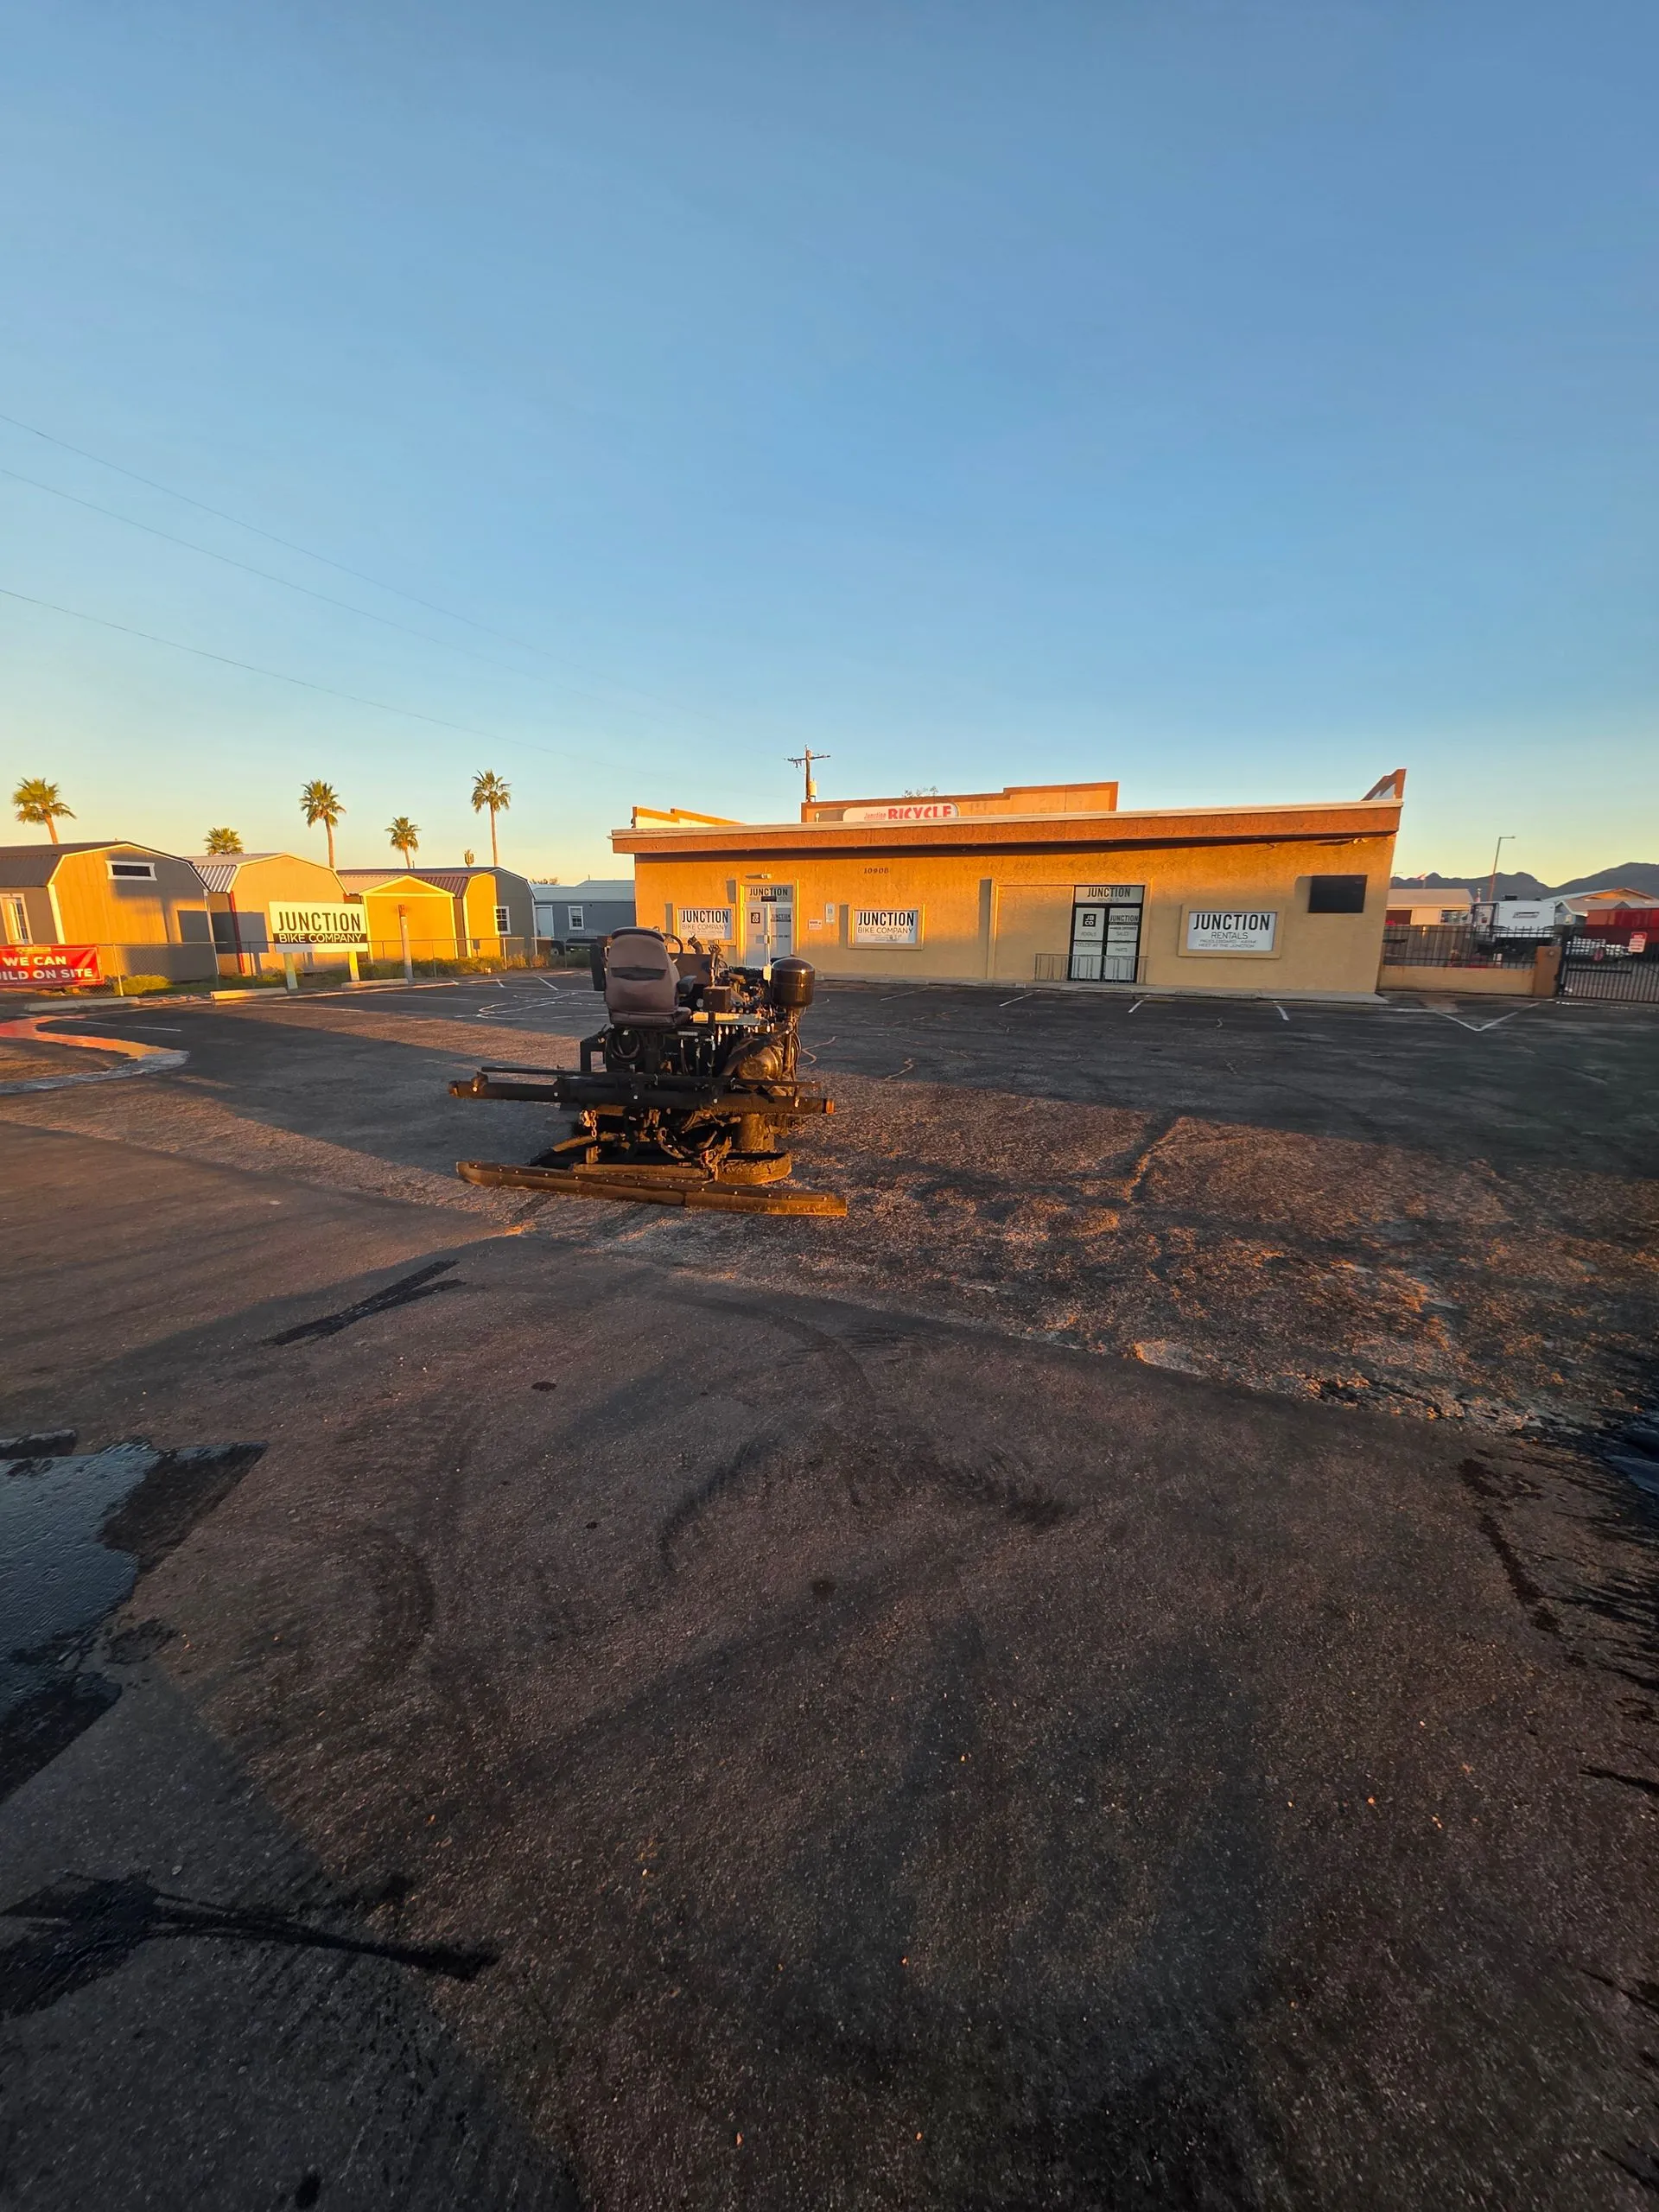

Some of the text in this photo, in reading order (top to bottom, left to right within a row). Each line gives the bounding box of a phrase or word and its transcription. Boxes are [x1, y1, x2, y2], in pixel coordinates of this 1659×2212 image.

[888, 805, 951, 820] BICYCLE
[749, 887, 788, 896] JUNCTION
[1087, 887, 1131, 897] JUNCTION
[278, 912, 361, 931] JUNCTION
[682, 910, 728, 923] JUNCTION
[858, 912, 914, 926] JUNCTION
[1193, 914, 1271, 931] JUNCTION
[279, 933, 362, 943] BIKE COMPANY
[1211, 931, 1249, 940] RENTALS
[3, 956, 67, 967] WE CAN
[33, 969, 56, 979] ON
[60, 968, 93, 978] SITE
